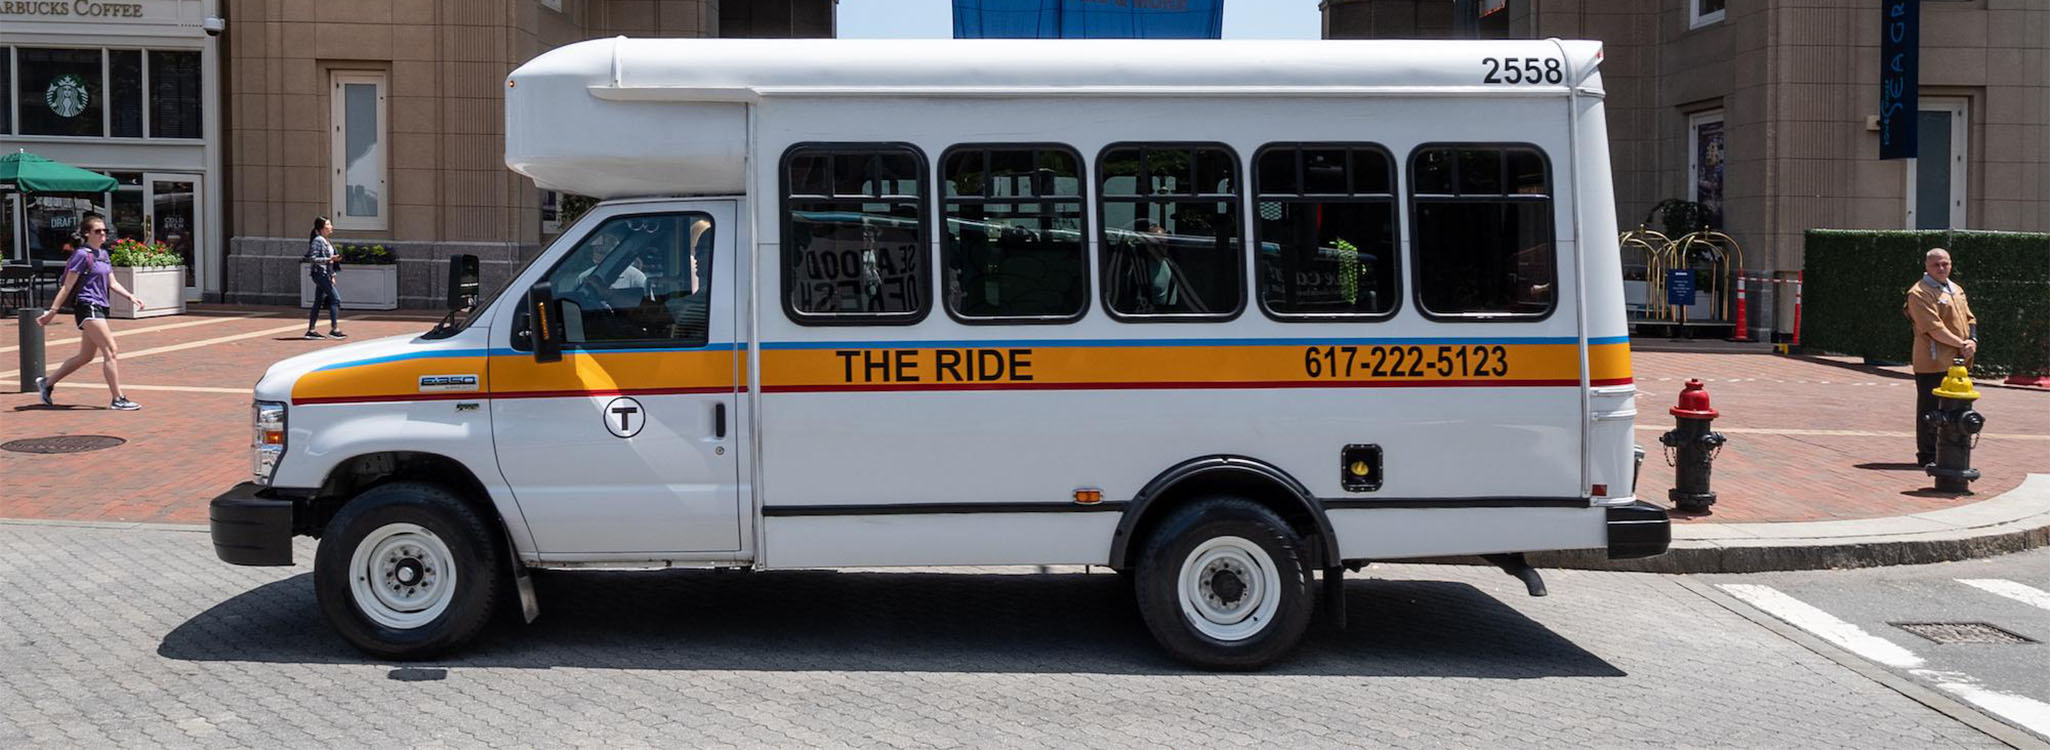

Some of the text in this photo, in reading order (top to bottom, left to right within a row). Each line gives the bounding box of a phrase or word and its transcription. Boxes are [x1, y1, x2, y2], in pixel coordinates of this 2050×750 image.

[1482, 57, 1563, 85] 2558
[50, 216, 77, 228] DRAFT
[836, 349, 1034, 382] THE RIDE
[1305, 346, 1508, 377] 617-222-5123
